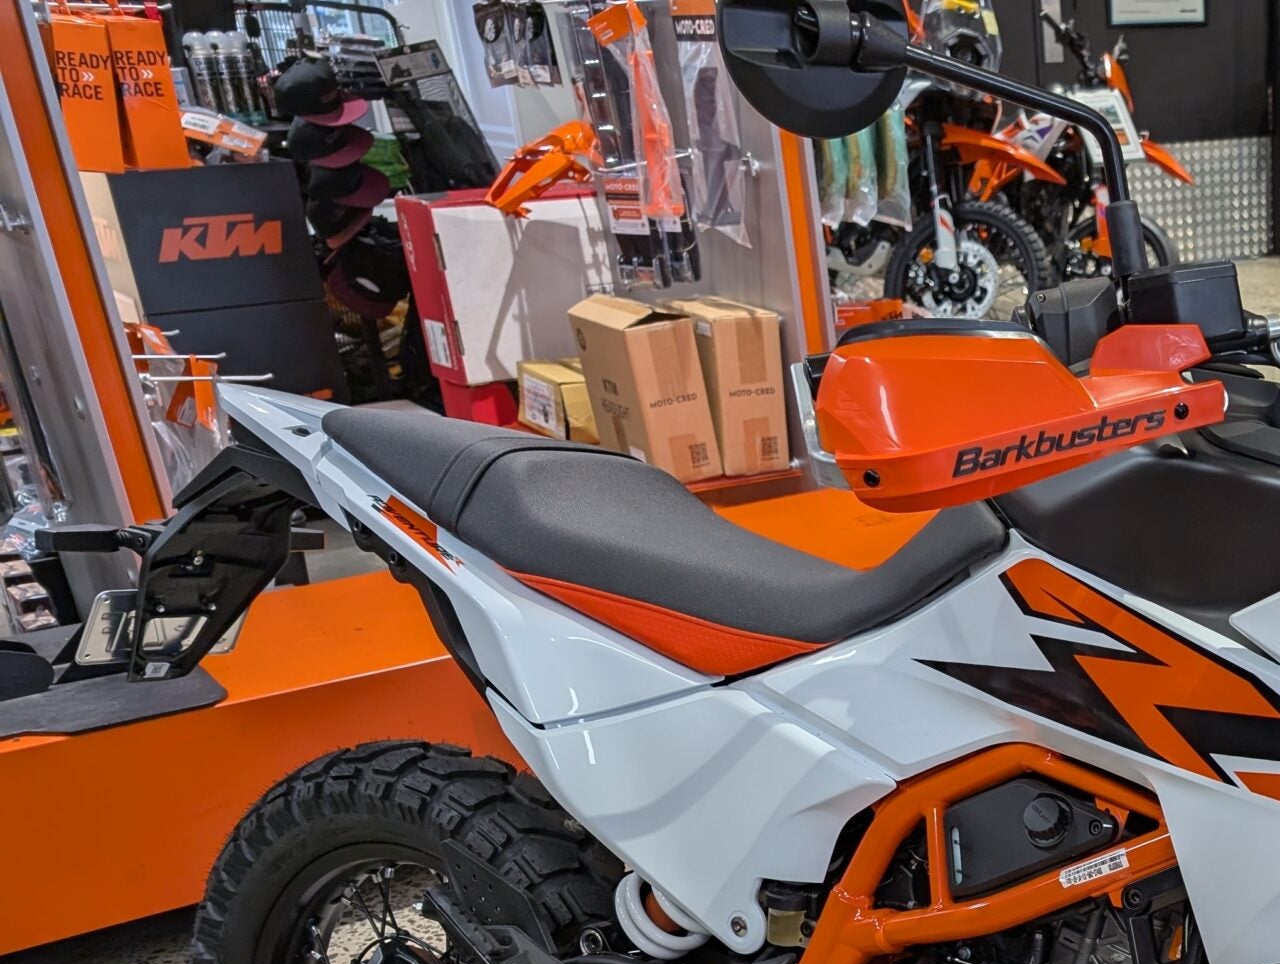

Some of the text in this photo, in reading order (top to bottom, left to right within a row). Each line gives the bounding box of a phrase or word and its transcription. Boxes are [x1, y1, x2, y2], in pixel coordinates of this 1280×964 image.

[675, 19, 715, 35] MOTO-CRED
[55, 50, 110, 70] READY
[114, 50, 166, 66] READY
[58, 66, 80, 82] TO
[118, 66, 140, 81] TO
[61, 83, 104, 101] RACE
[120, 81, 165, 97] RACE
[158, 214, 283, 263] KTM
[649, 393, 698, 408] MOTO-CRED
[729, 387, 776, 398] MOTO-CRED
[952, 409, 1167, 478] Barkbusters
